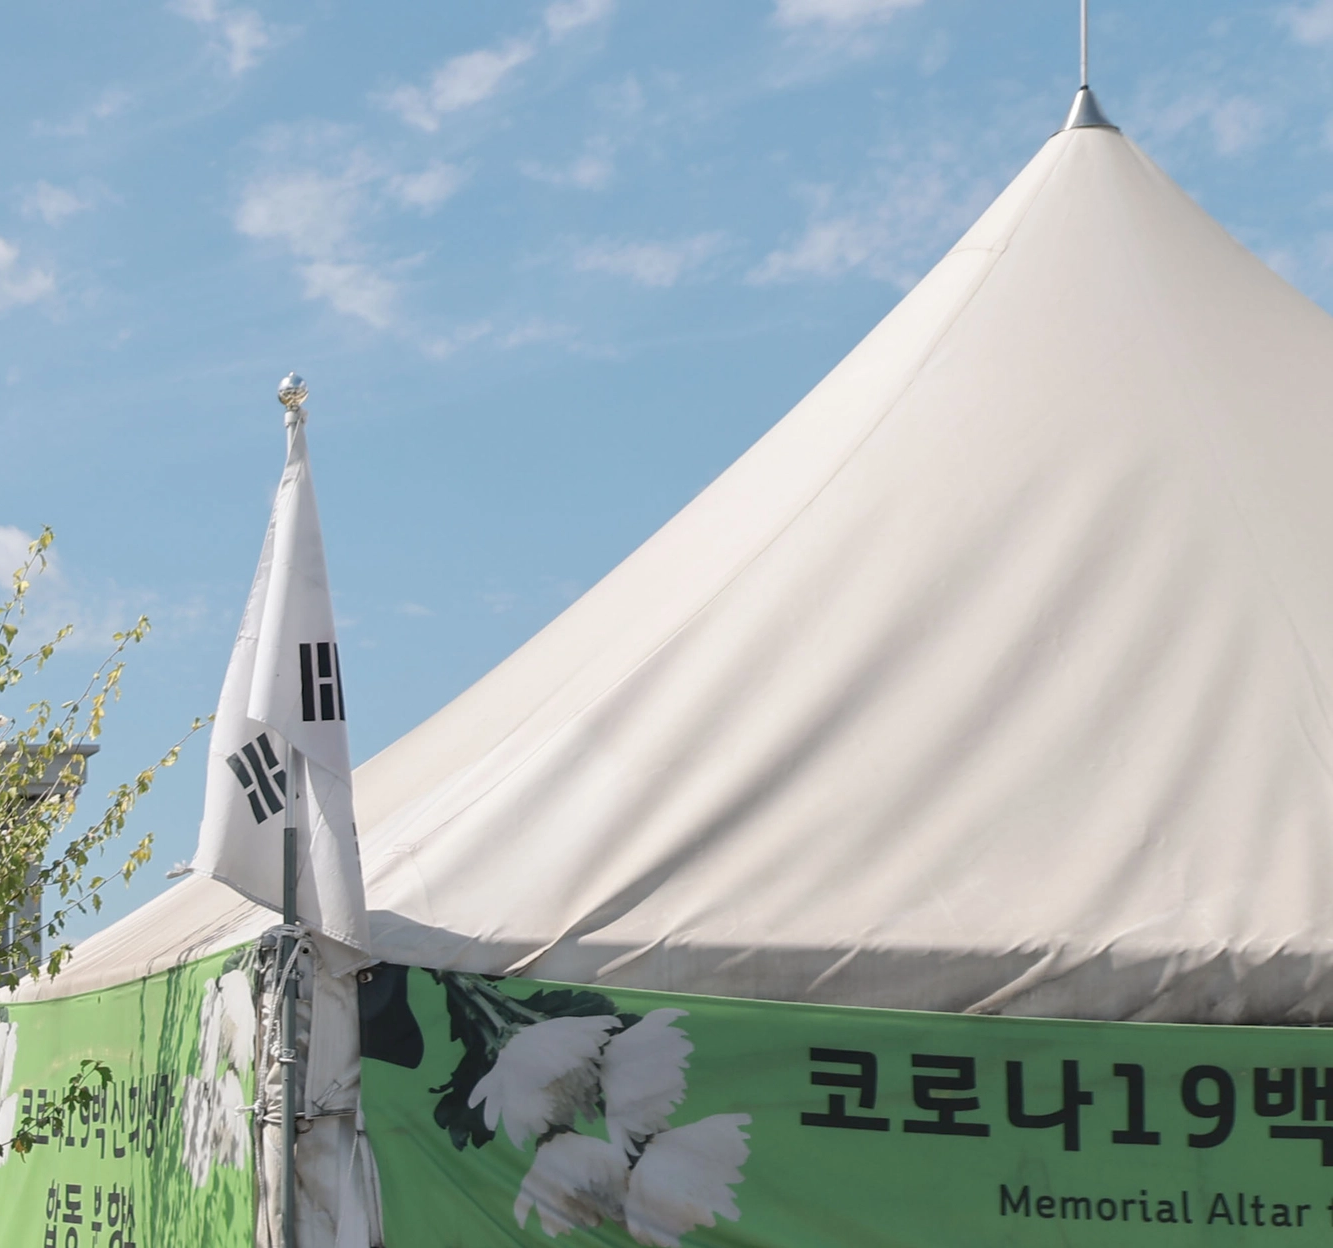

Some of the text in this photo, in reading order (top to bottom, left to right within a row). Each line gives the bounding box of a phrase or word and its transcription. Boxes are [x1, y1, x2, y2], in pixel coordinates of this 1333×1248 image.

[800, 1046, 1333, 1167] 코로나19백
[999, 1184, 1192, 1225] Memorial
[1207, 1192, 1311, 1228] Altar
